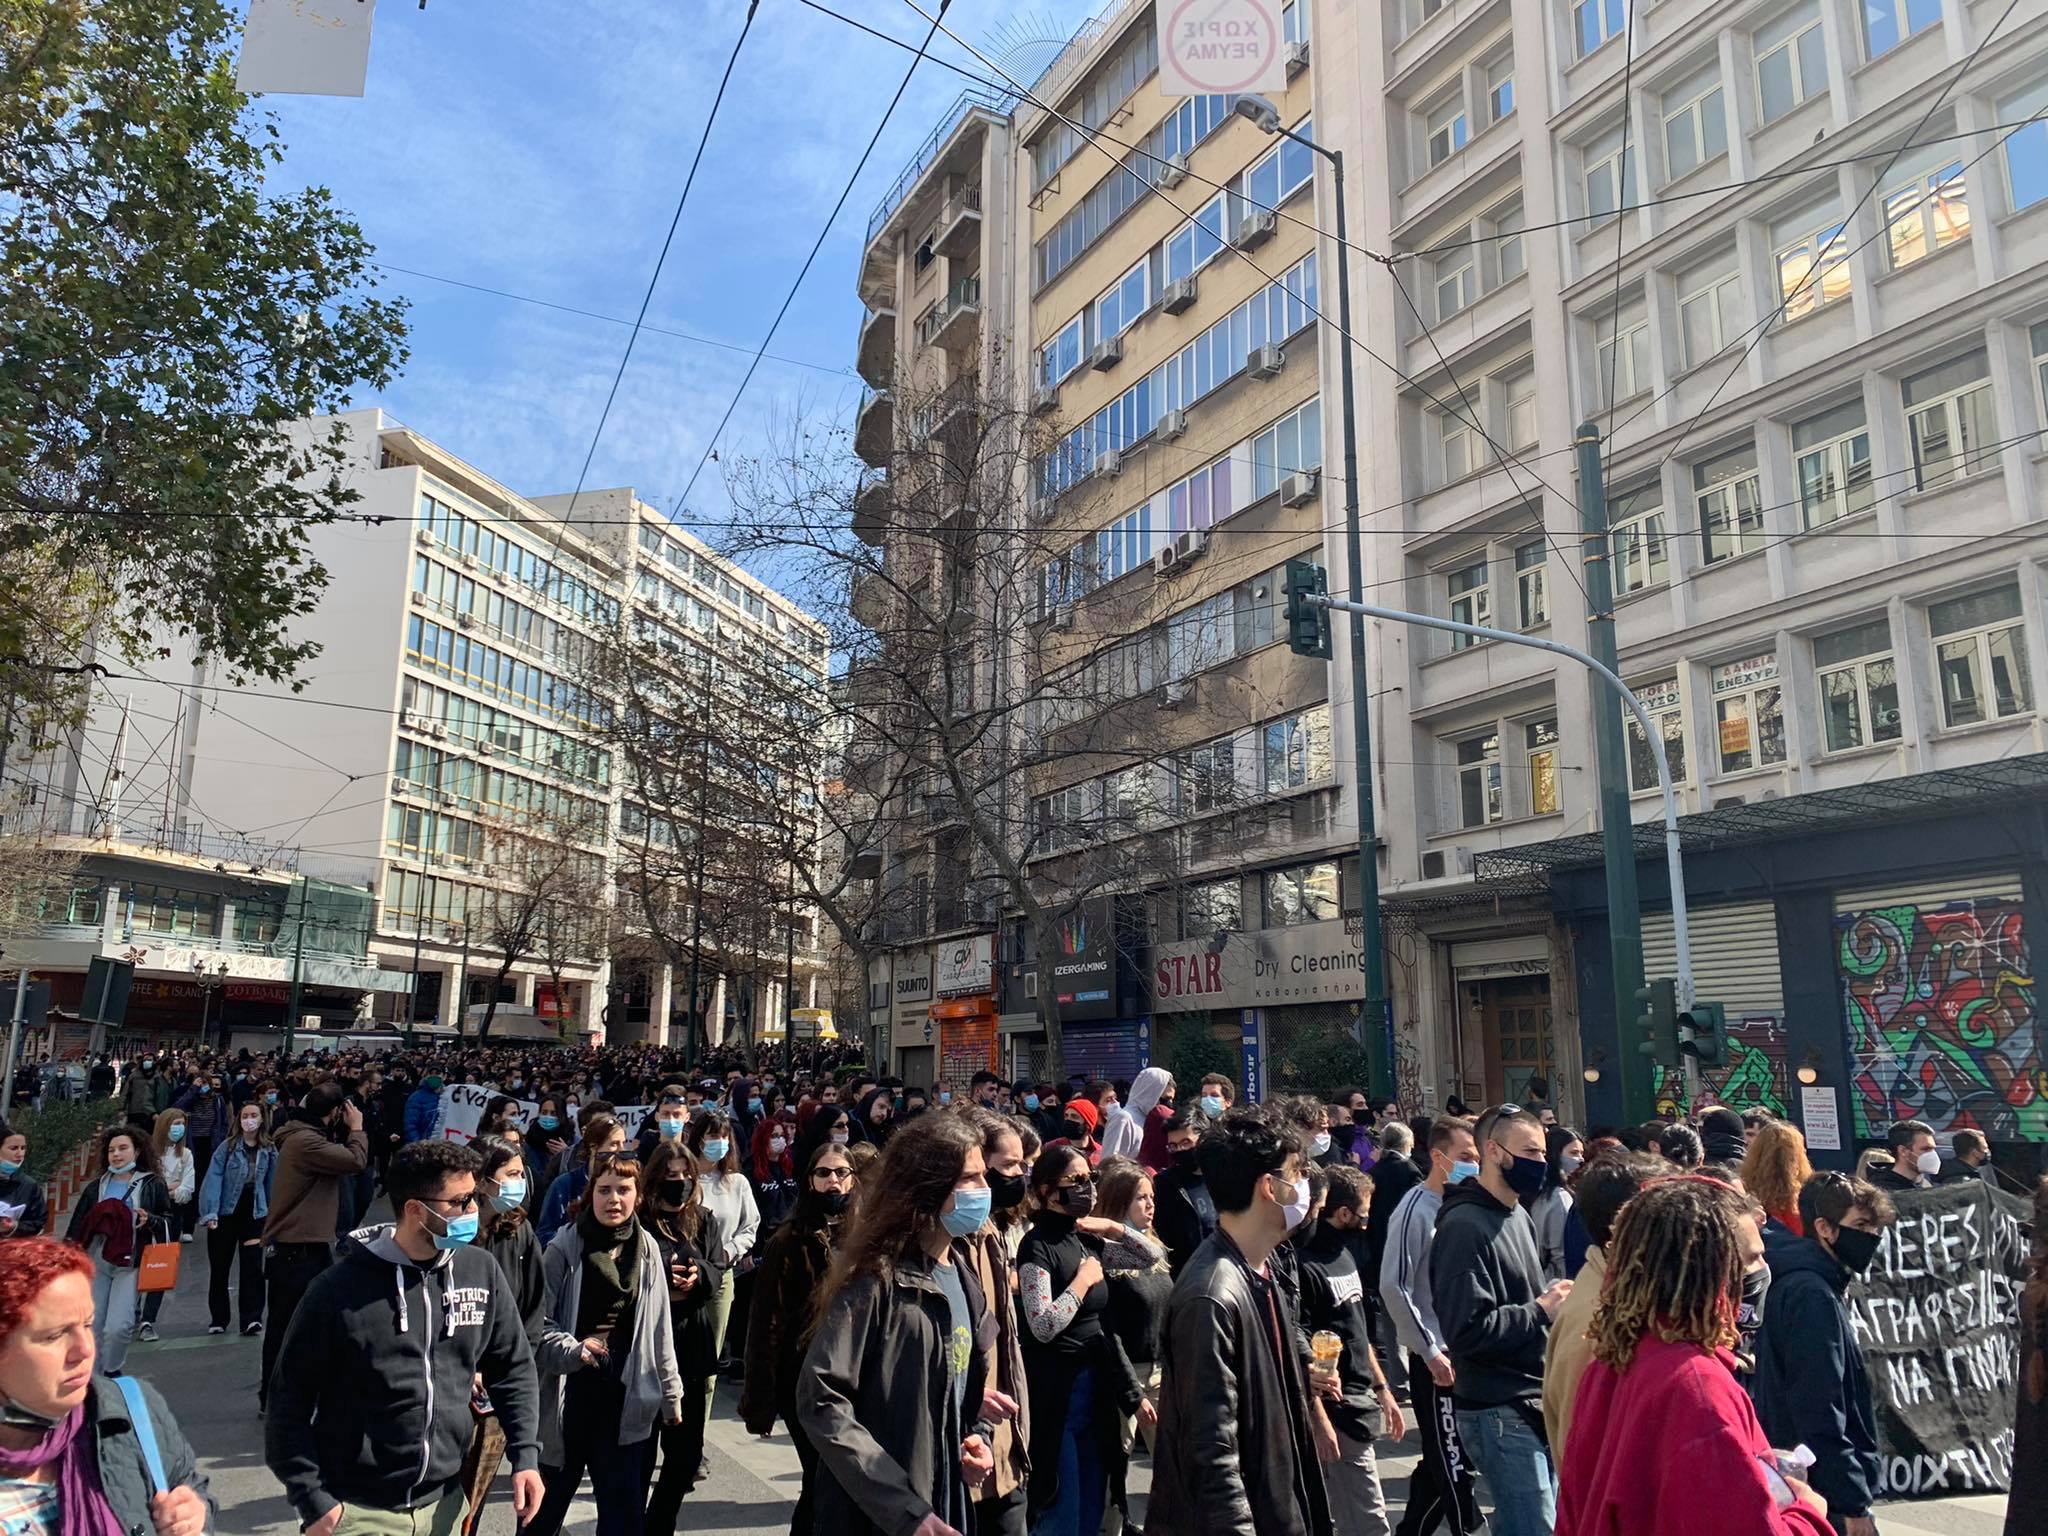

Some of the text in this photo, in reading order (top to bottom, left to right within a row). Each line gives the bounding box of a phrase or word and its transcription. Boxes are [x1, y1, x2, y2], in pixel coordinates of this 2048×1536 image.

[1723, 656, 1776, 677] ΔΑΝΕΙΑ
[1156, 952, 1224, 999] STAR
[1255, 950, 1366, 979] Dry Cleaning
[225, 984, 290, 1001] ΣΟΥΒΛΑΚΙ
[896, 976, 929, 994] SUUNTO
[1255, 983, 1360, 998] Καθαριστήρι
[442, 1287, 490, 1306] DSTRICT
[1847, 1282, 1979, 1345] ΑΓΡΑΦΕΣ
[1886, 1356, 1934, 1409] ΝΑ
[1439, 1396, 1464, 1483] ROYAL
